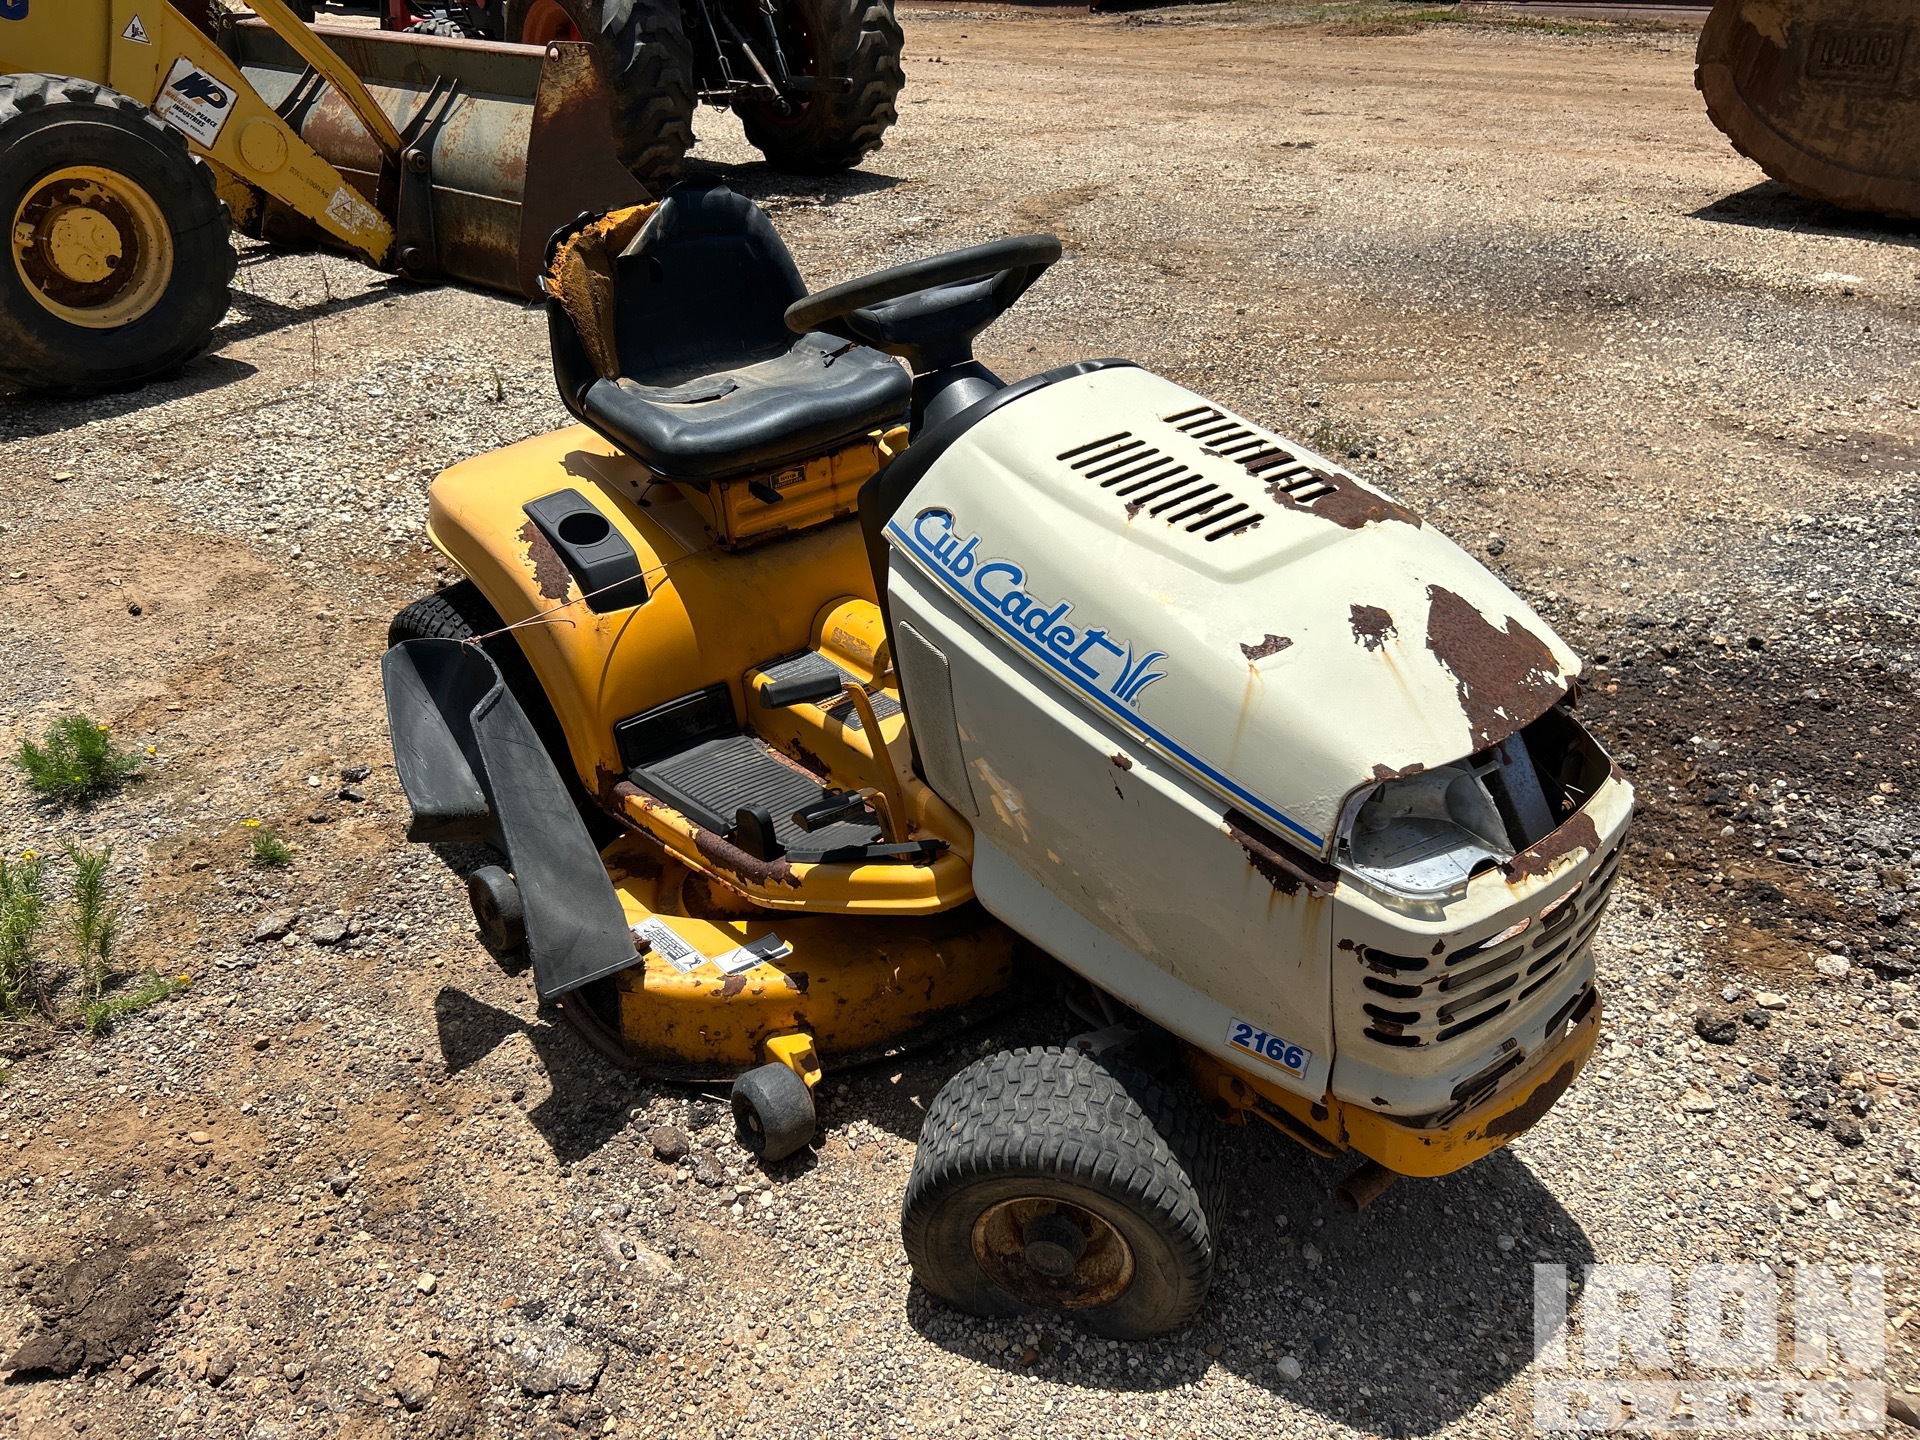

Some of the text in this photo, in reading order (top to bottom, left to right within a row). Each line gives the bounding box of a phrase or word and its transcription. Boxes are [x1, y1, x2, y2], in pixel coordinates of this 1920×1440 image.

[172, 103, 206, 127] INDUSTRIES
[320, 188, 330, 199] kg
[914, 515, 980, 577] Cub
[974, 562, 1125, 679] Cadet
[1232, 1023, 1304, 1068] 2166
